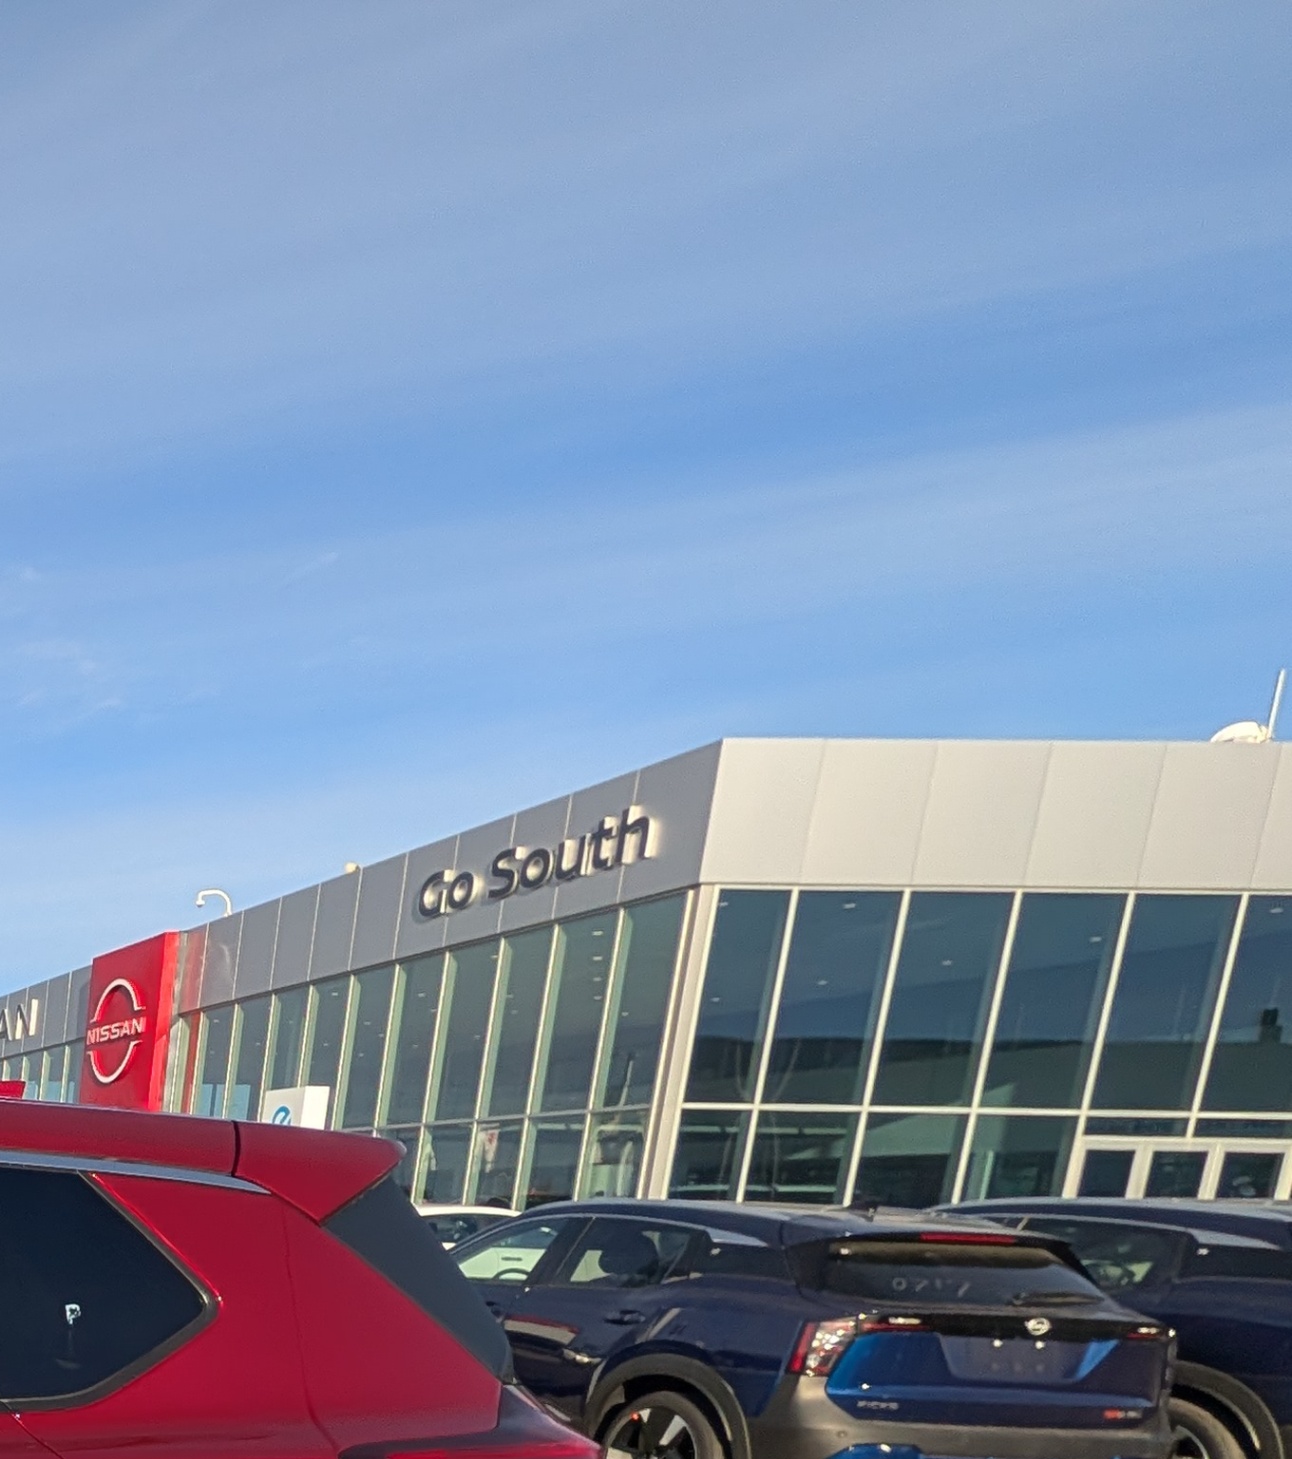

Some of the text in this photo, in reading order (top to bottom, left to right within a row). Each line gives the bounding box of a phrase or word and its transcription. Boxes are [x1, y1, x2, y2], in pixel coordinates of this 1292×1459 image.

[418, 804, 655, 917] Go South
[86, 1016, 147, 1046] NISSAN
